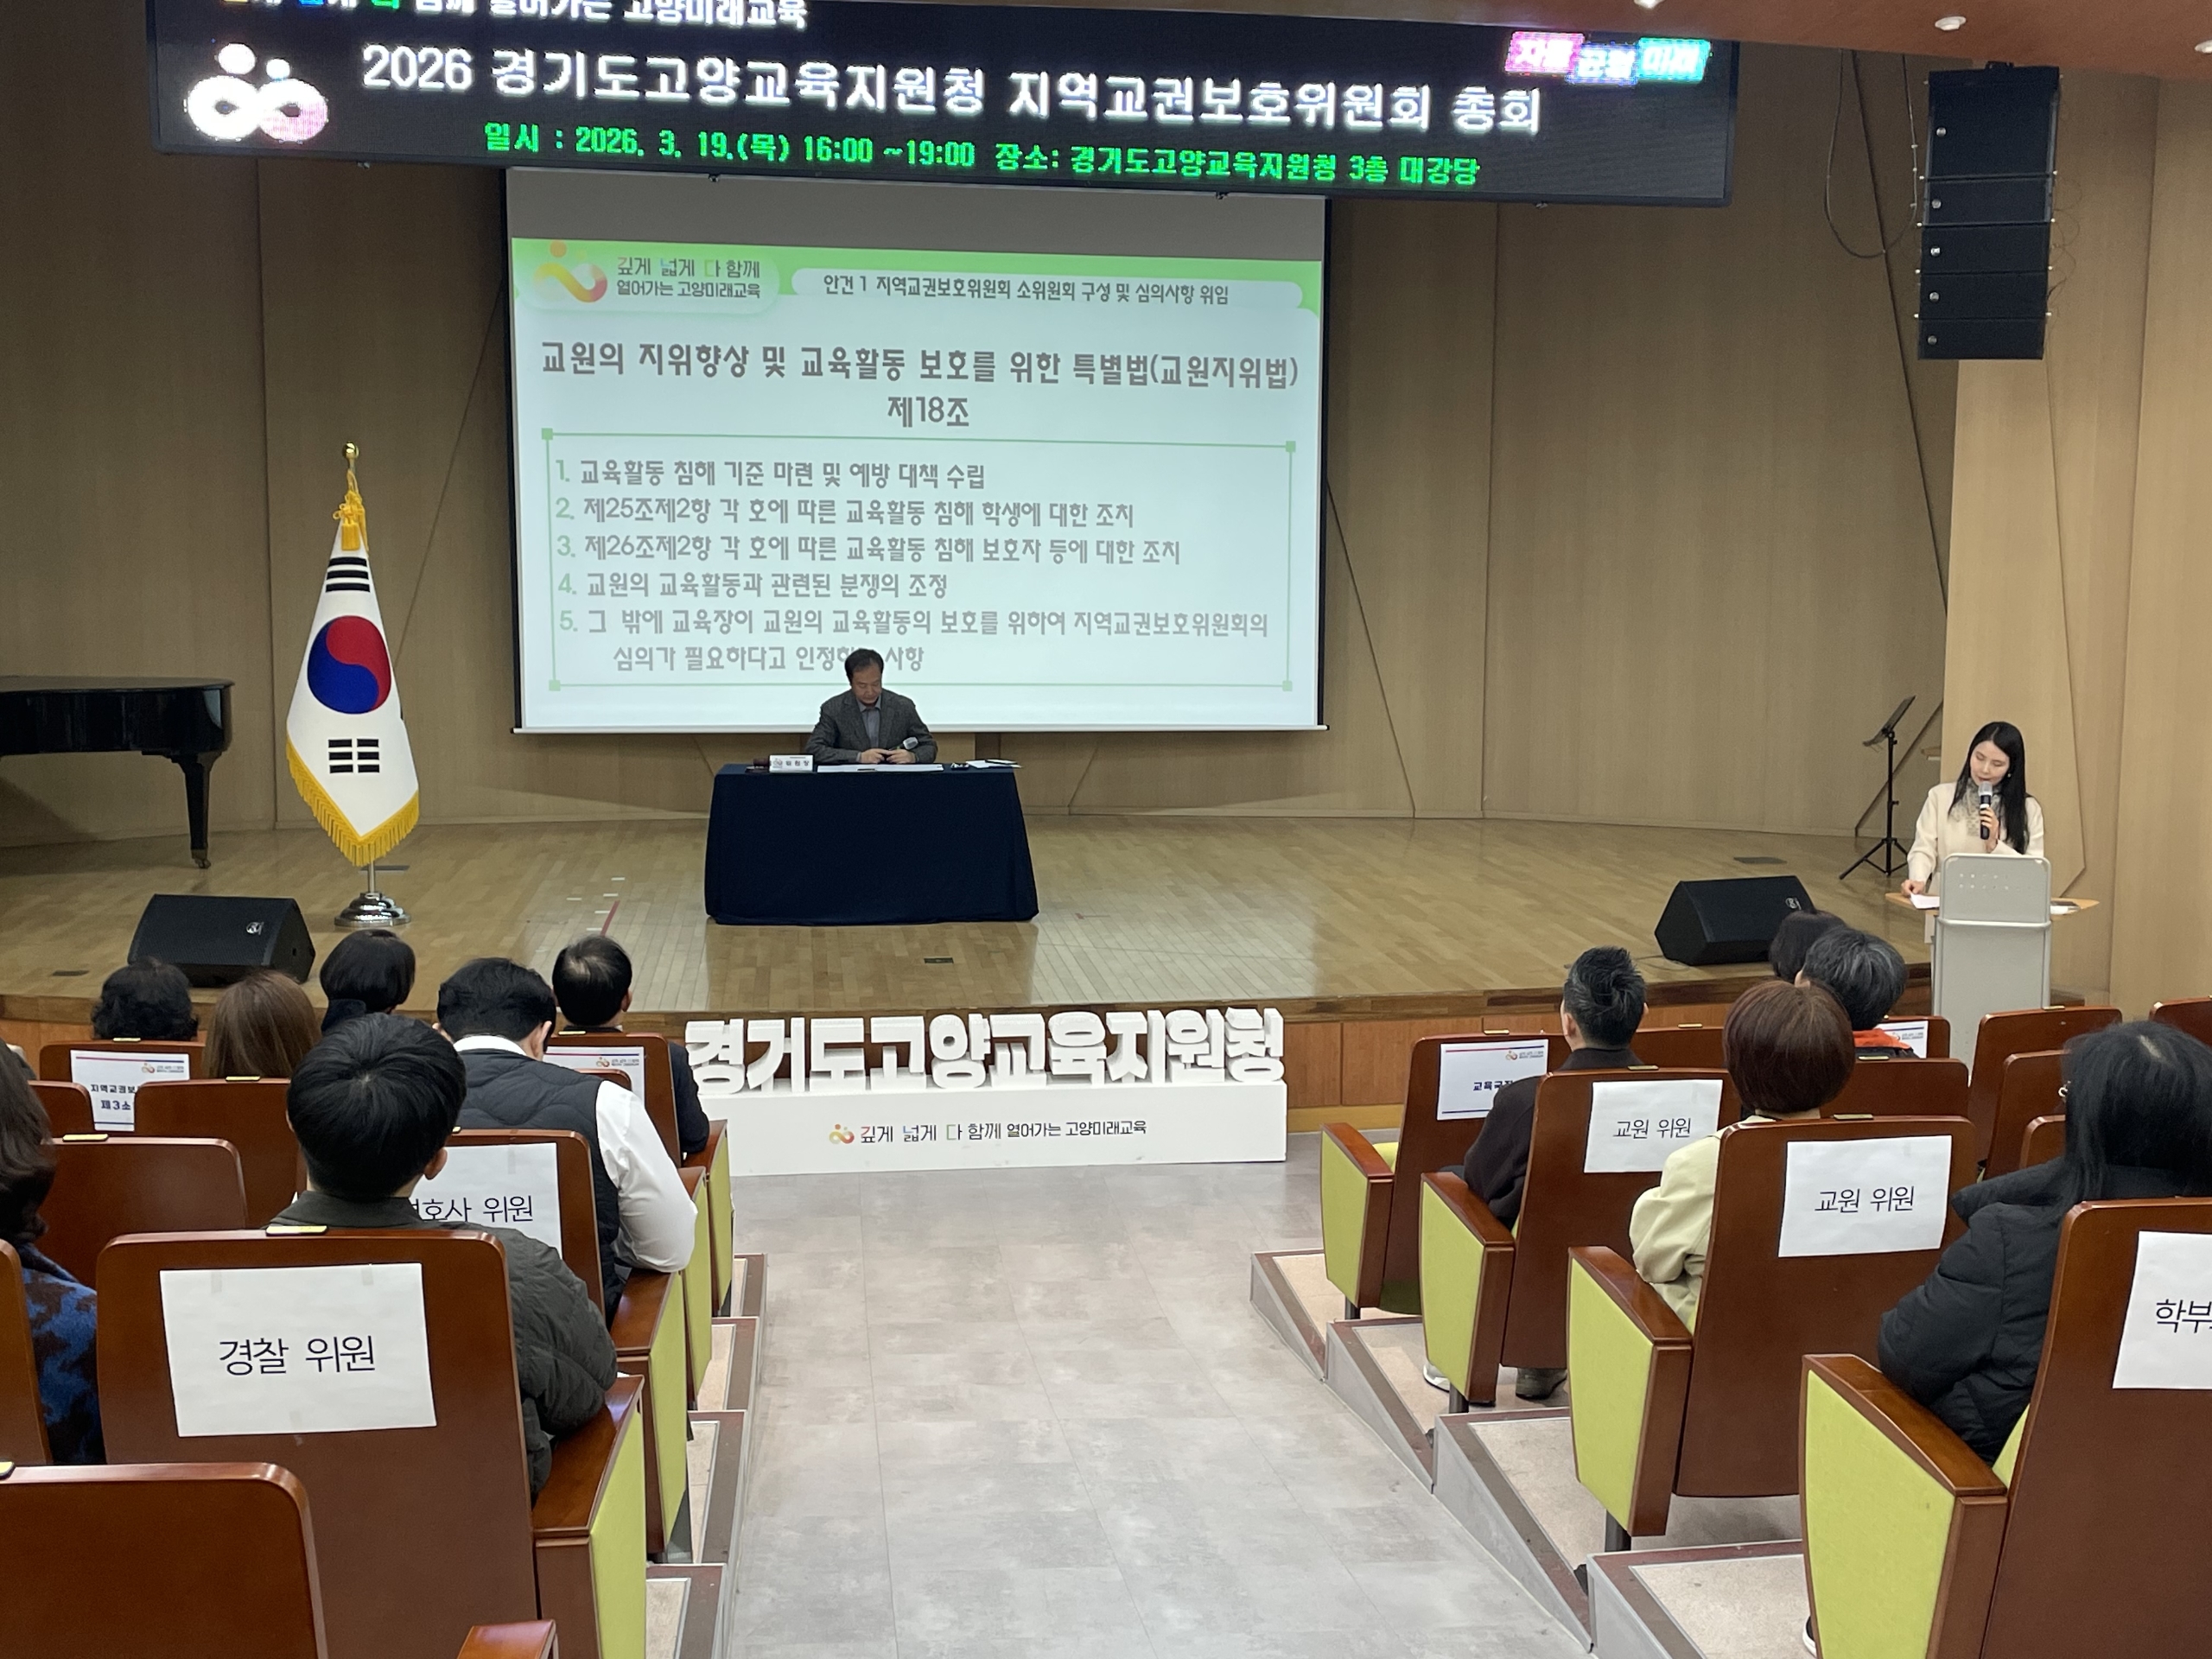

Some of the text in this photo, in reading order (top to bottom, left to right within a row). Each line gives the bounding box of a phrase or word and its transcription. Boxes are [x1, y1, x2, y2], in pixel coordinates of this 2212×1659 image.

[363, 44, 1541, 135] 2026 경기도고양교육지원청 지역교권보호위원회 총회
[485, 122, 540, 154] 일시
[575, 126, 645, 156] 2026.
[658, 130, 682, 158] 3.
[697, 130, 790, 162] 19.(목)
[804, 135, 874, 163] 16:00
[995, 143, 1059, 171] 장소:
[1070, 145, 1337, 181] 경기도고양교육지원청
[1349, 155, 1388, 184] 3층
[1400, 156, 1481, 186] 대강당
[618, 257, 760, 278] 깊게 넓게 다 함께
[617, 279, 760, 299] 열어가는 고양미래교육
[823, 274, 854, 295] 안건
[876, 276, 1011, 300] 지역교권보호위원회
[1016, 280, 1076, 302] 소위원회
[1081, 282, 1111, 302] 구성
[1116, 283, 1130, 303] 및
[1135, 283, 1194, 305] 심의사항
[1199, 284, 1229, 305] 위임
[542, 341, 1299, 390] 교원의 지위향상 및 교육활동 보호를 위한 특별법(교원지위법)
[887, 396, 969, 428] 제18조
[556, 459, 985, 490] 1. 교육활동 침해 기준 마련 및 예방 대책 수립
[556, 498, 1134, 528] 2. 제25조제2항 각 호에 따른 교육활동 침해 학생에 대한 조치
[556, 535, 1180, 565] 3. 제26조제2항 각 호에 따른 교육활동 침해 보호자 등에 대한 조치
[558, 572, 948, 599] 4. 교원의 교육활동과 관련된 분쟁의 조정
[559, 609, 1268, 638] 5. 그 밖에 교육장이 교원의 교육활동의 보호를 위하여 지역교권보호위원회의
[613, 646, 676, 671] 심의가
[685, 646, 785, 671] 필요하다고
[885, 646, 925, 671] 사항
[685, 1008, 1286, 1095] 경기도고양교육지원청
[91, 1084, 139, 1094] 지역교권보
[860, 1120, 1147, 1143] 깊게 넓게 다 함께 열어가는 고양미래교육
[1612, 1117, 1691, 1139] 교원 위원
[411, 1195, 533, 1223] 호사 위원
[1815, 1185, 1915, 1213] 교원 위원
[2156, 1299, 2212, 1333] 학부
[219, 1335, 375, 1376] 경찰 위원
